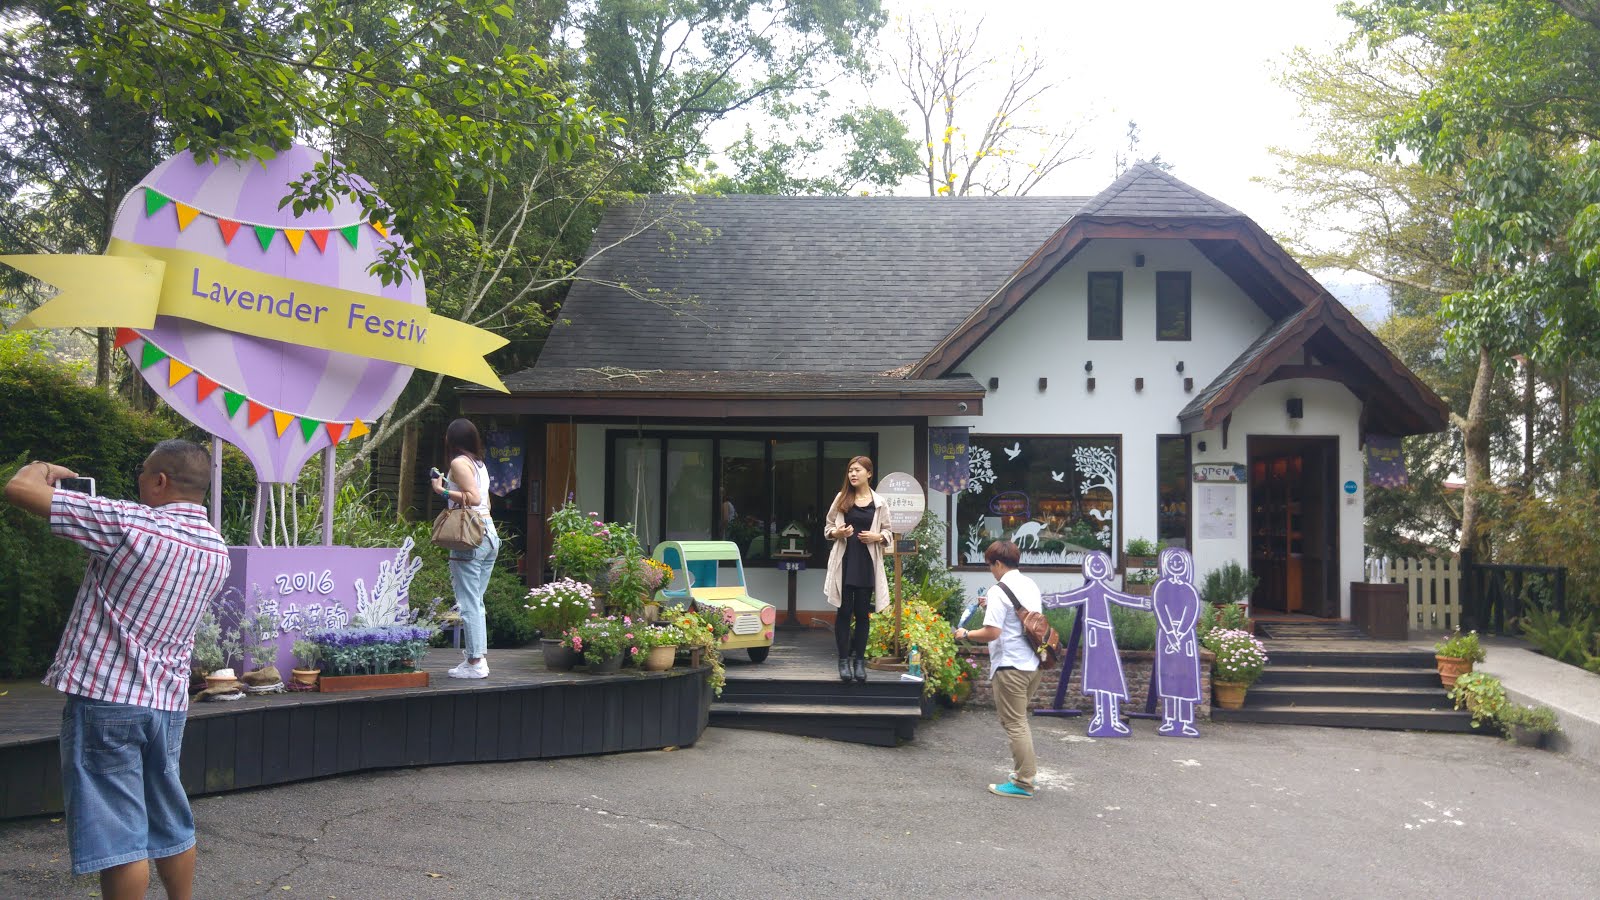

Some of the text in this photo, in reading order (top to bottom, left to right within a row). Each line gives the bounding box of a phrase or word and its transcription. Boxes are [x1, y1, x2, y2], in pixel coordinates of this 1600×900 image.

[192, 268, 329, 324] Lavender
[1201, 467, 1230, 477] OPEN
[276, 570, 334, 595] 2016
